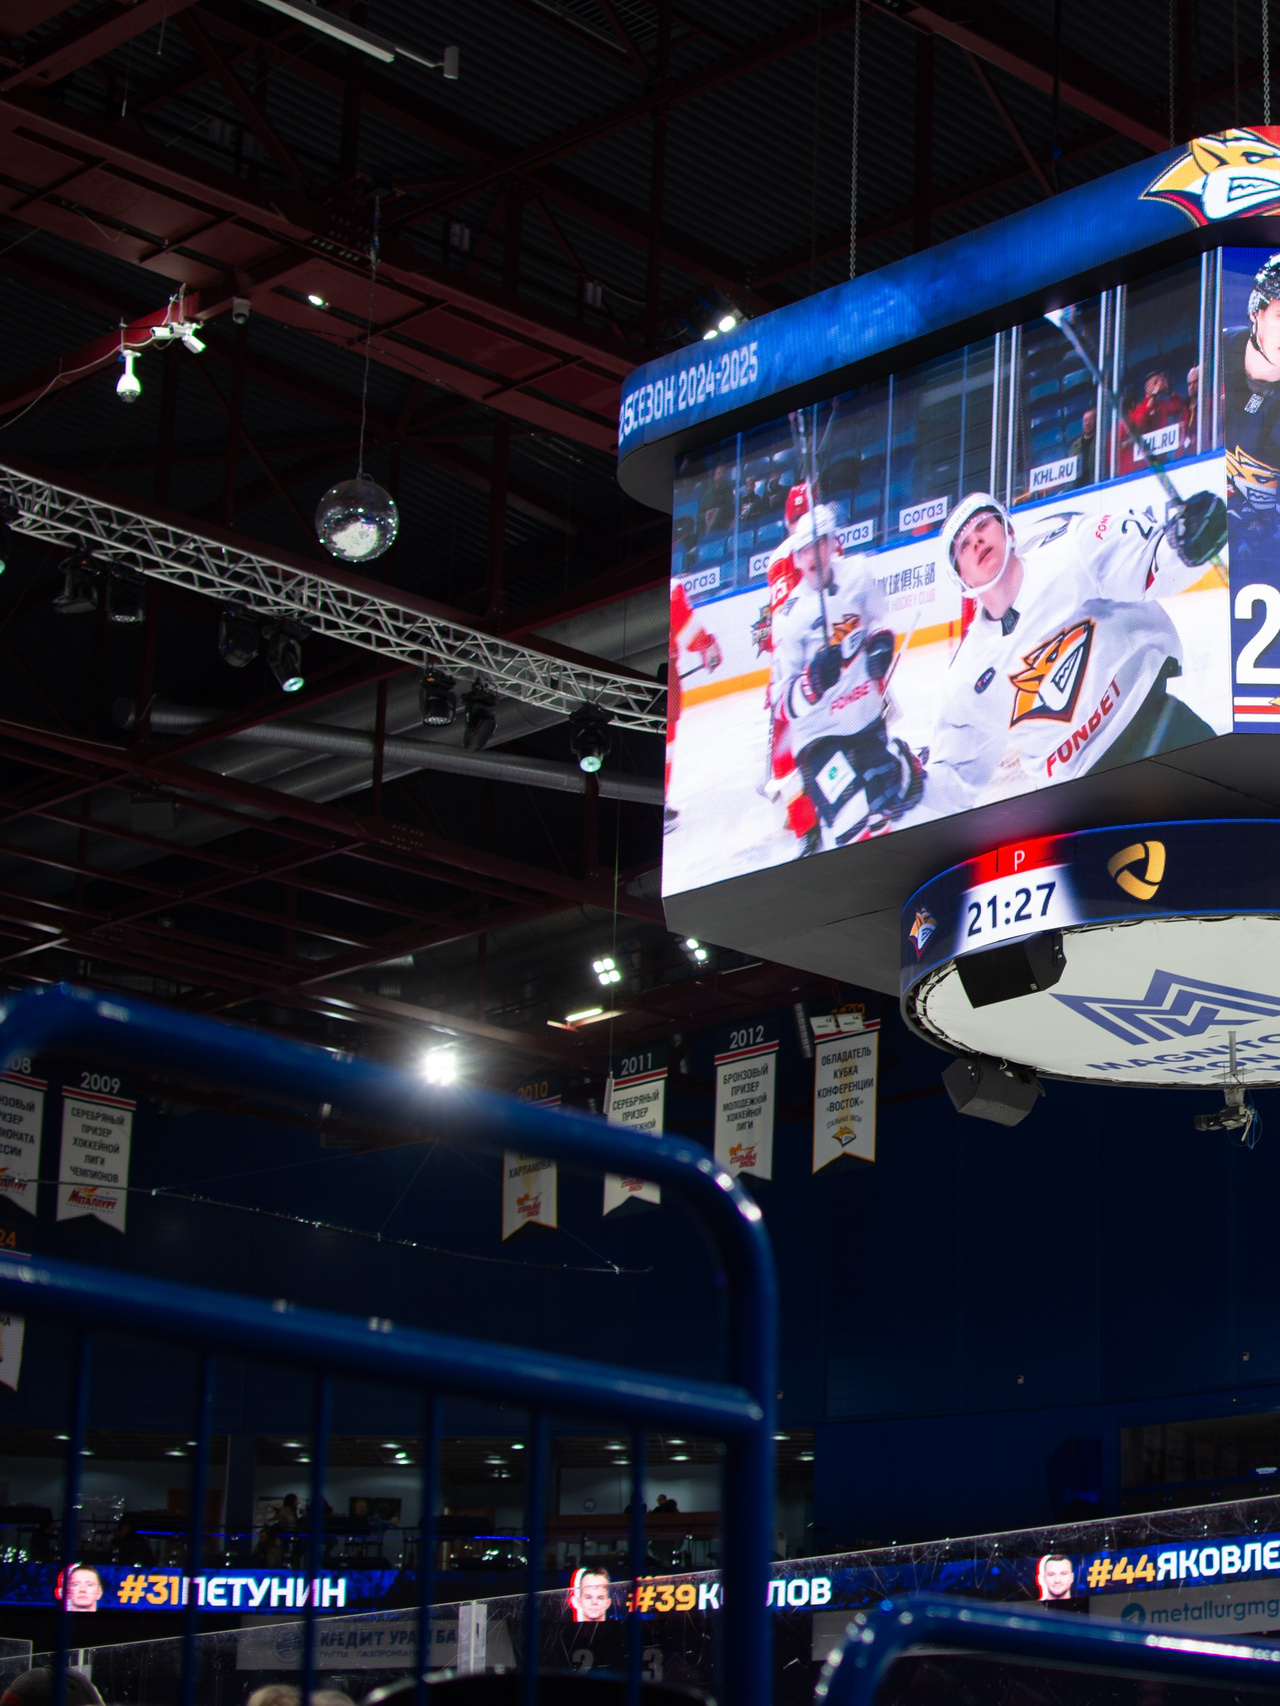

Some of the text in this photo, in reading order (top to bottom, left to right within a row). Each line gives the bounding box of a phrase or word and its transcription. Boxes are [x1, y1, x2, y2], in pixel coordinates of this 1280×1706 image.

[677, 341, 759, 412] 2024-2025
[1033, 461, 1075, 487] KHL.RU
[903, 500, 945, 526] согаз
[1046, 675, 1122, 778] FONBET
[967, 881, 1056, 938] 21:27
[729, 1025, 765, 1050] 2012
[620, 1052, 652, 1076] 2011
[821, 1046, 872, 1067] ОБЛАДАТЕЛЬ
[1161, 1052, 1280, 1075] IRON
[723, 1063, 769, 1085] БРОНЗОВЫЙ
[833, 1064, 859, 1080] КУБКА
[79, 1071, 122, 1095] 2009
[516, 1080, 549, 1102] 2010
[730, 1081, 760, 1097] ПРИЗЕР
[817, 1078, 874, 1099] КОНФЕРЕНЦИИ
[612, 1089, 660, 1112] СЕРЕБРЯНЫЙ
[826, 1098, 865, 1113] «ВОСТОК»
[70, 1107, 125, 1126] СЕРЕБРЯНЫЙ
[622, 1107, 649, 1122] ПРИЗЕР
[726, 1106, 762, 1123] ХОККЕЙНОЙ
[81, 1124, 113, 1138] ПРИЗЕР
[736, 1120, 754, 1132] ЛИГИ
[72, 1137, 120, 1154] ХОККЕЙНОЙ
[84, 1154, 105, 1166] ЛИГИ
[69, 1166, 119, 1183] ЧЕМПИОНОВ
[320, 1631, 384, 1649] КРЕДИТ
